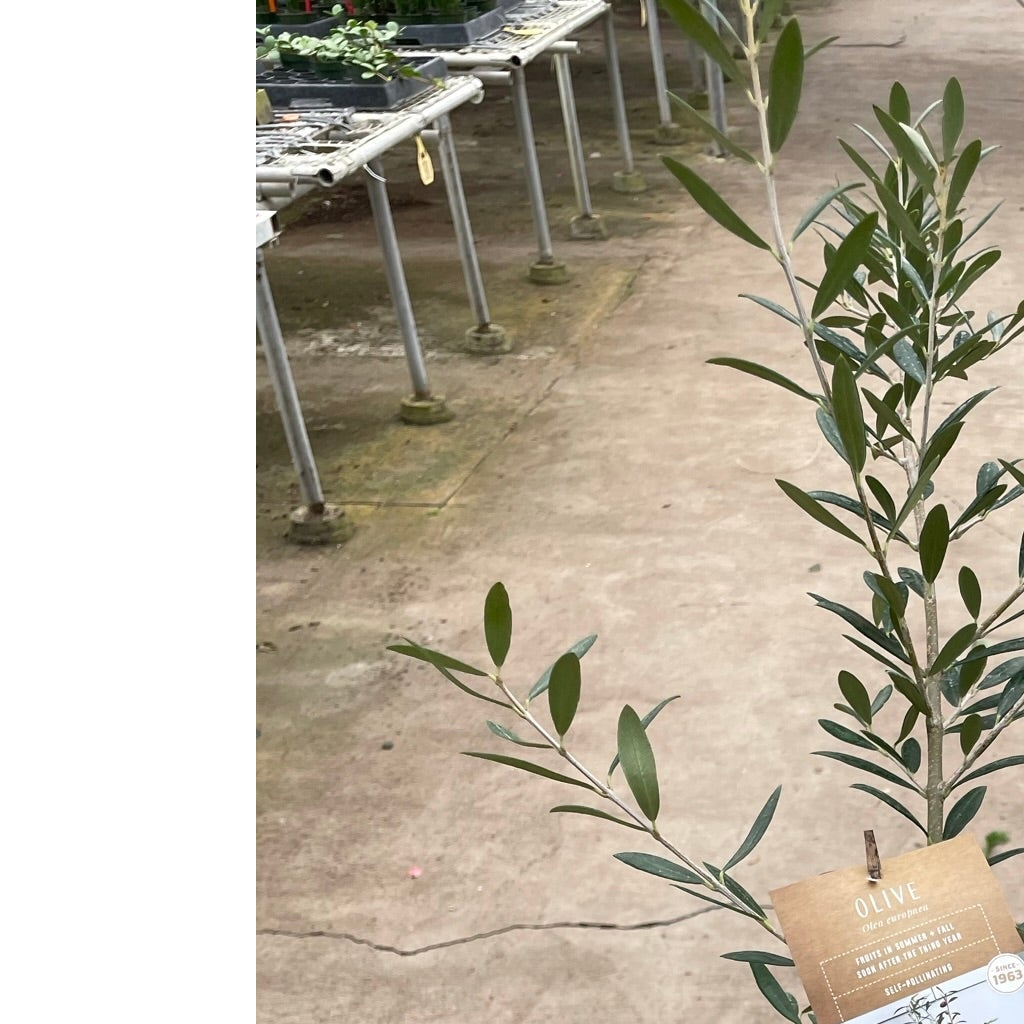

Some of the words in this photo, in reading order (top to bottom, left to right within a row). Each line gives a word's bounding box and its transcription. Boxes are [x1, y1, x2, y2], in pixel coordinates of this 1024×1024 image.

[855, 881, 920, 918] OLIVE
[862, 920, 884, 933] Olea
[886, 904, 929, 925] europaea
[855, 949, 882, 966] FRUITS
[883, 944, 893, 955] IN
[894, 932, 928, 951] SUMMER
[936, 922, 955, 935] FALL
[856, 965, 877, 979] SOON
[878, 955, 902, 971] AFTER
[902, 948, 918, 961] THE
[918, 939, 941, 955] THIRD
[942, 932, 962, 945] YEAR
[884, 963, 953, 996] SELF-POLLINATING
[992, 969, 1023, 986] 1963
